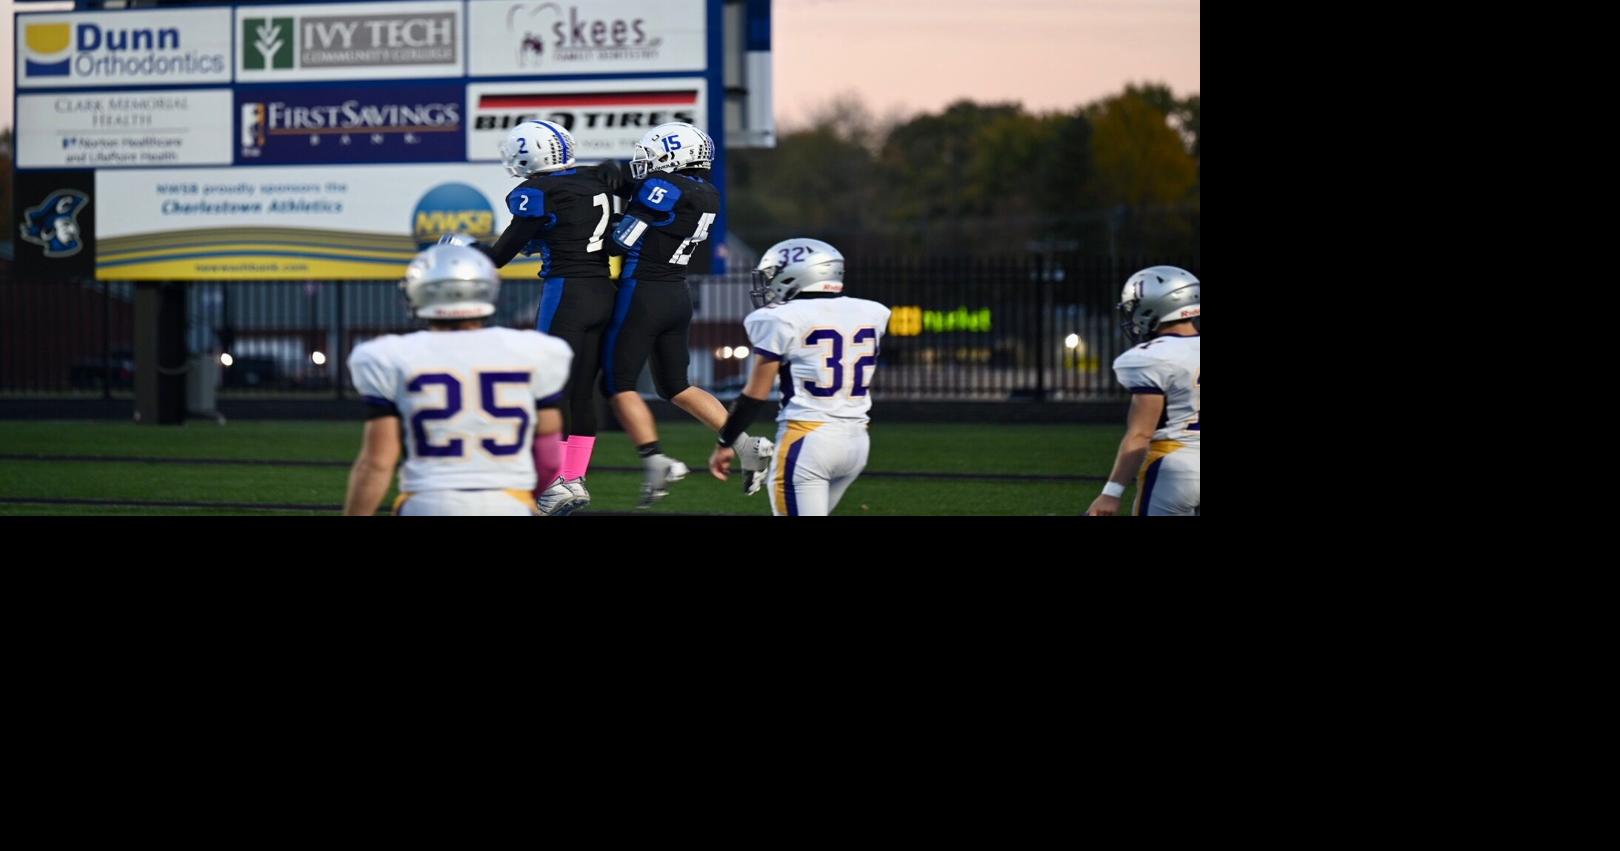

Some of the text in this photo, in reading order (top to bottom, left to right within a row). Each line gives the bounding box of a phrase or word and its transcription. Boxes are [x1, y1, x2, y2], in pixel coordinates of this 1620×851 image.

[305, 17, 450, 49] IVY TECH
[552, 6, 647, 47] skees
[76, 23, 180, 52] Dunn
[75, 51, 225, 77] Orthodontics
[55, 97, 188, 114] CLARK MEMORIAL
[92, 114, 152, 127] HEALTH
[584, 111, 696, 128] TIRES
[516, 137, 529, 154] 2
[661, 134, 682, 153] 15
[518, 194, 529, 211] 2
[647, 186, 668, 204] 15
[161, 199, 344, 216] Charlestown Athletics
[415, 211, 495, 237] NWSB
[586, 192, 610, 253] 2
[778, 246, 805, 266] 32
[803, 327, 878, 397] 32
[406, 370, 533, 458] 25
